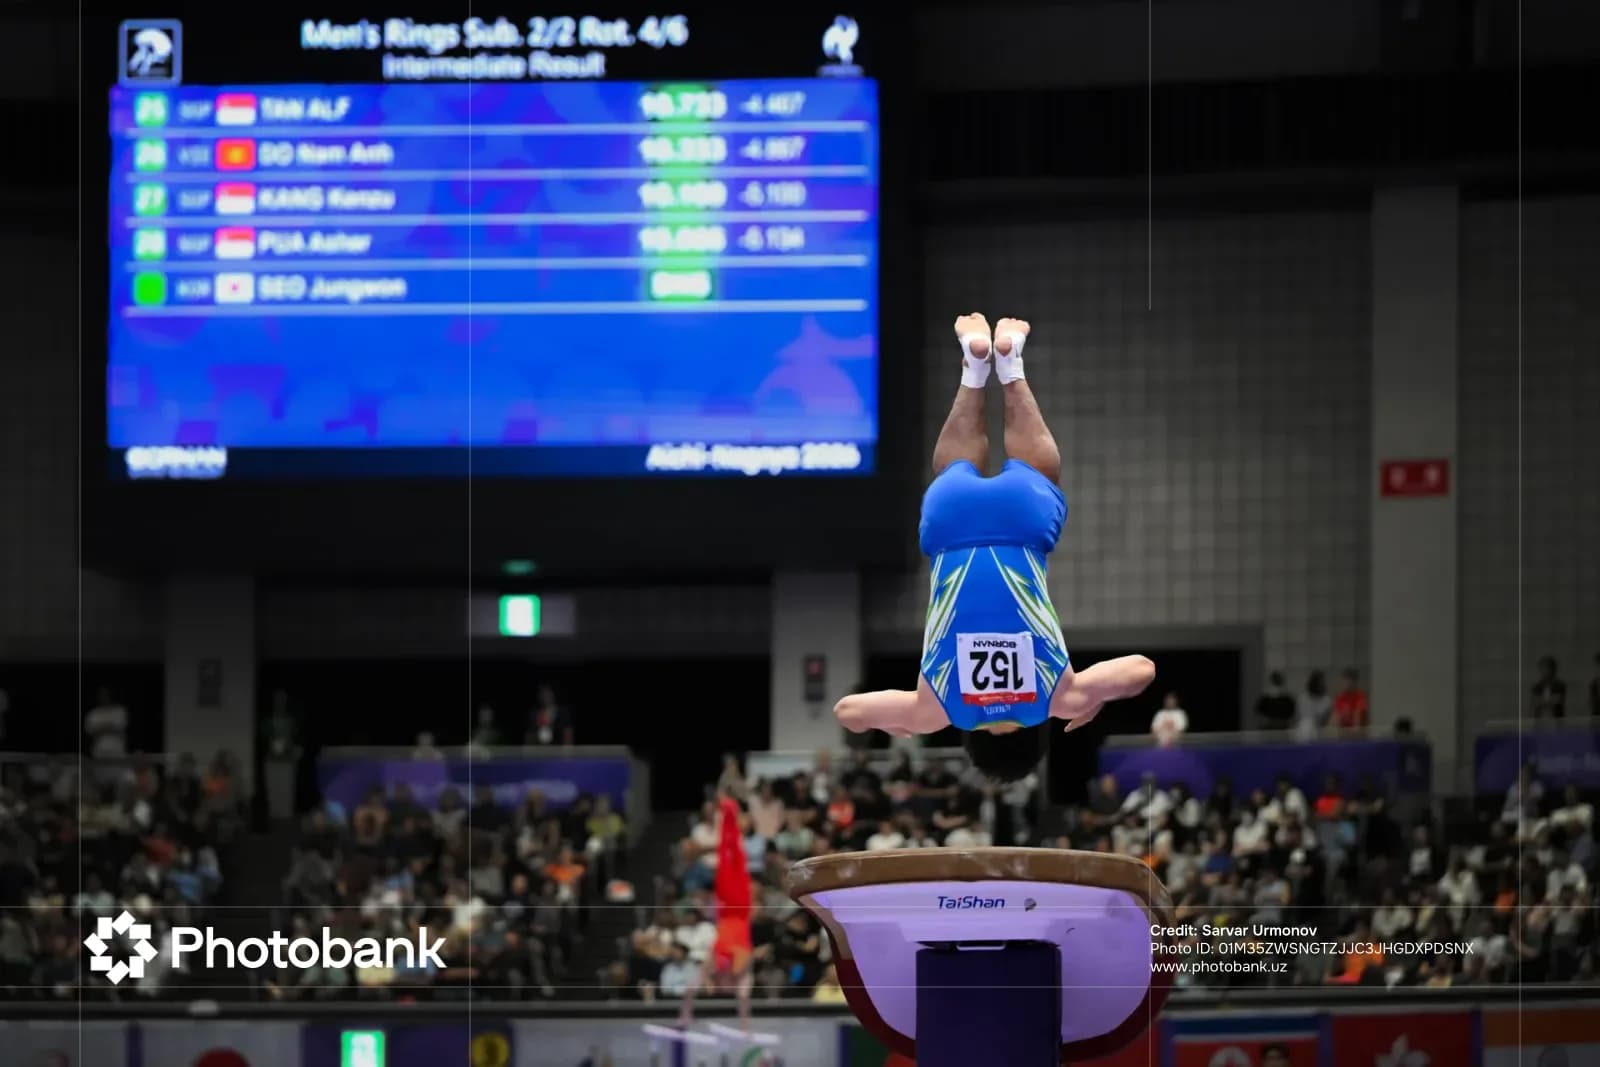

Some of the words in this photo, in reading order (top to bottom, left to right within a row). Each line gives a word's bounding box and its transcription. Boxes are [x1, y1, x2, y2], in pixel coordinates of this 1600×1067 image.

[302, 20, 380, 48] Men's
[384, 18, 459, 54] Rings
[463, 18, 523, 47] Sub.
[527, 16, 575, 48] 2/2
[579, 16, 635, 47] Rot.
[638, 16, 689, 48] 4/6
[383, 55, 526, 80] Intermediate
[529, 52, 605, 79] Result
[969, 650, 1024, 691] 152
[937, 896, 1005, 909] TaiShan
